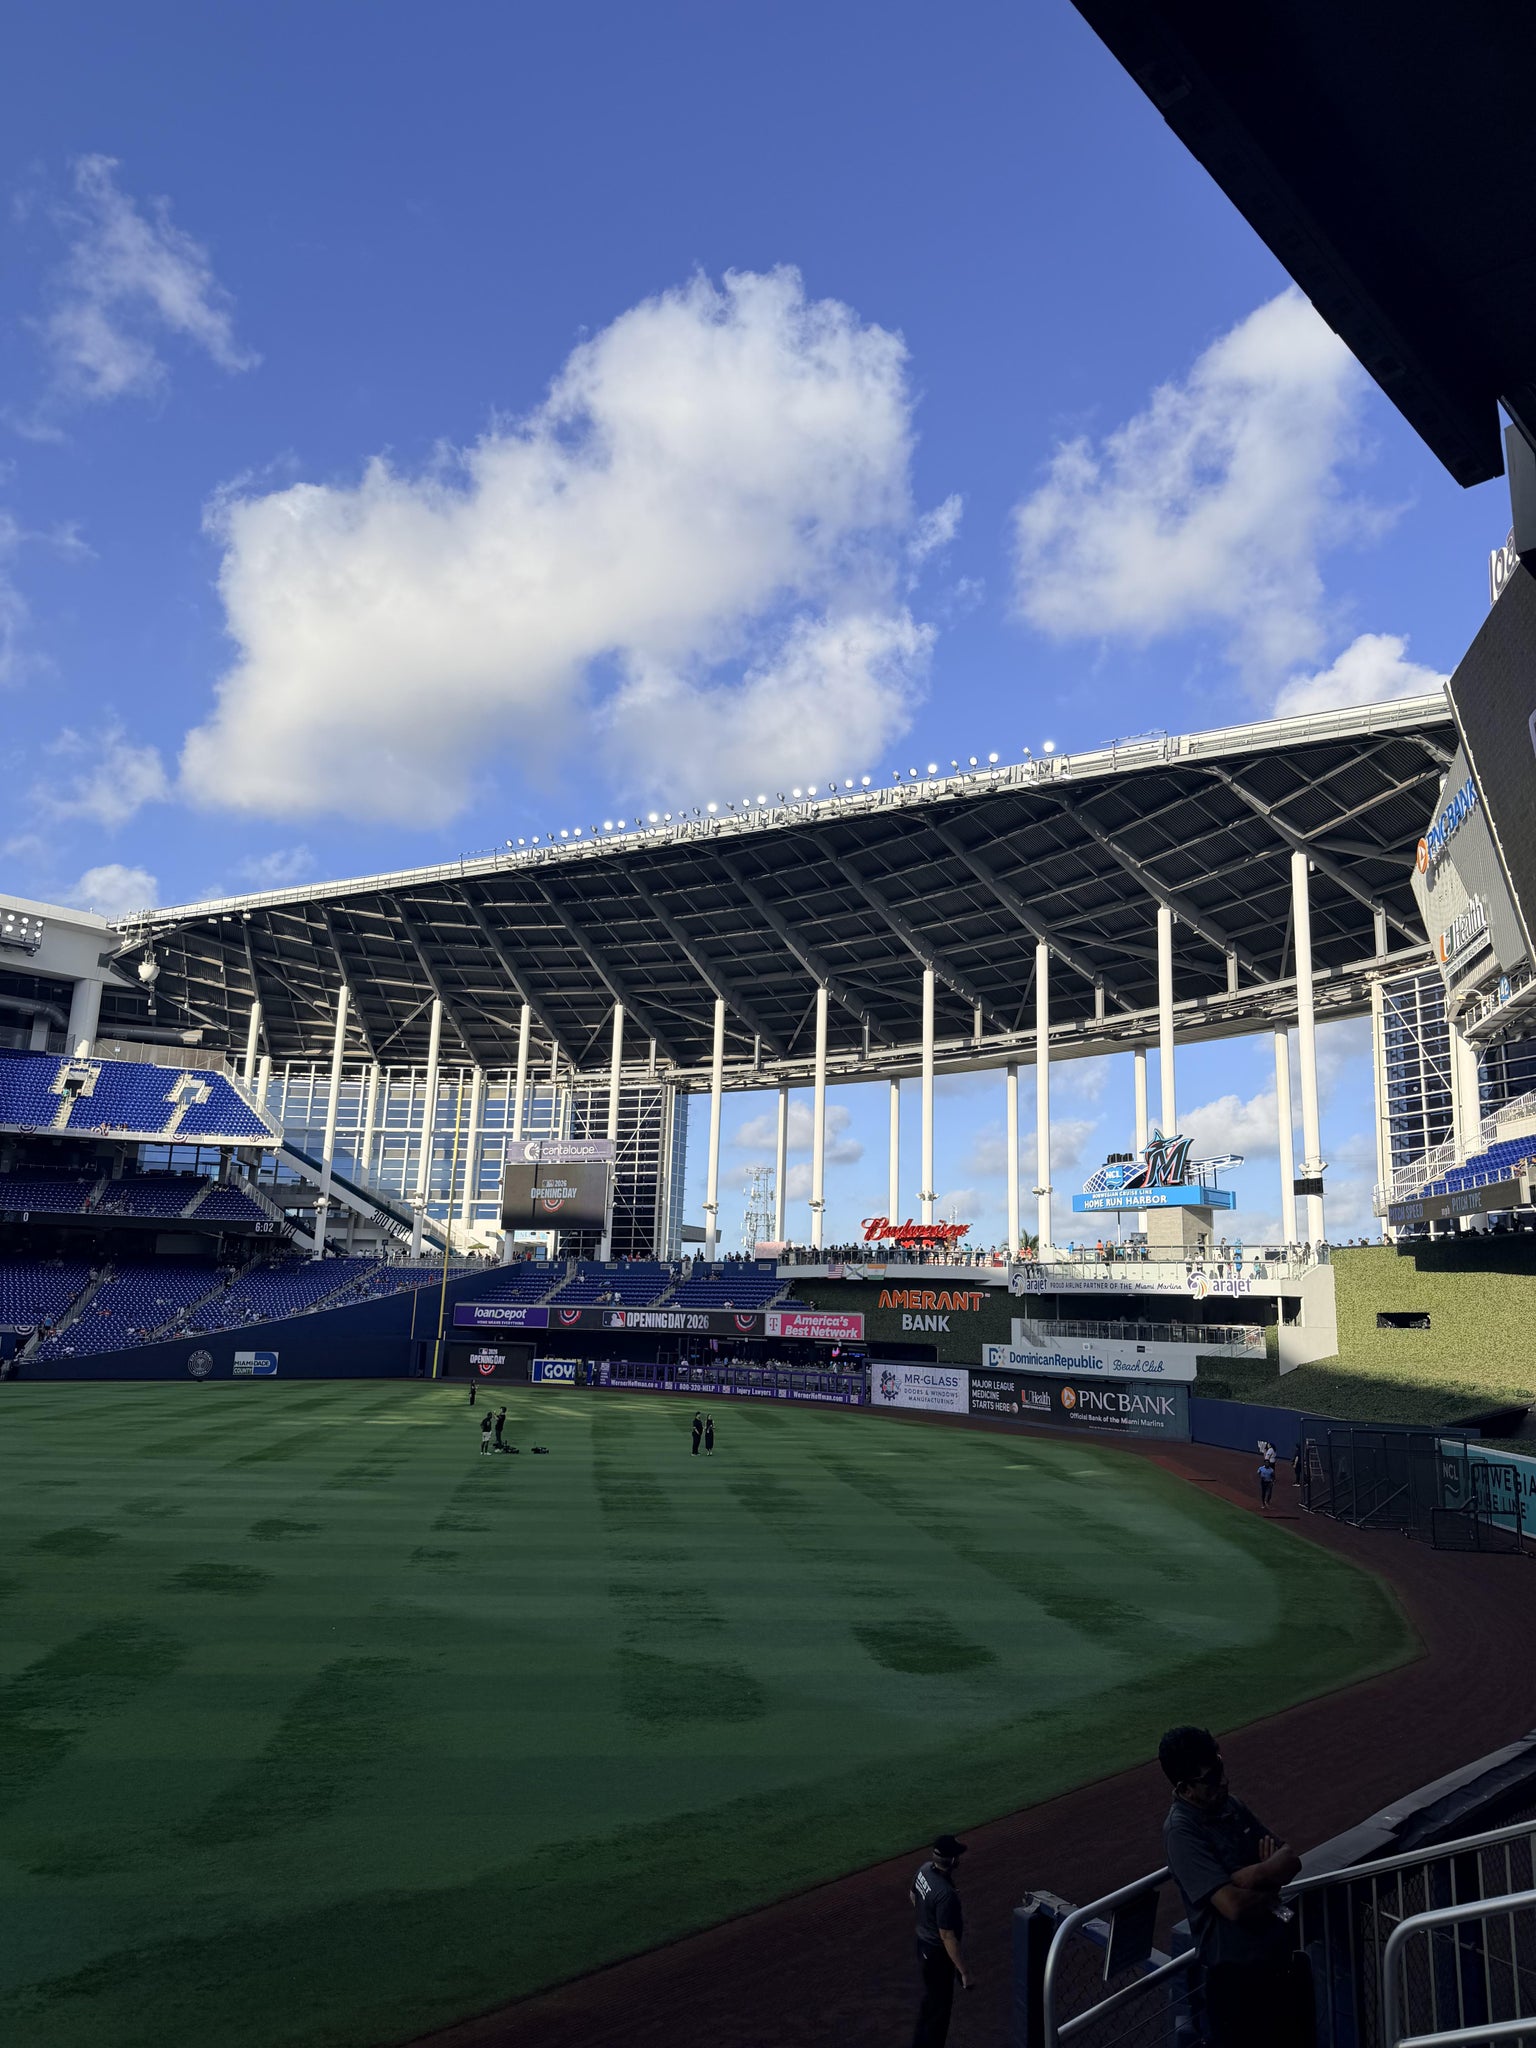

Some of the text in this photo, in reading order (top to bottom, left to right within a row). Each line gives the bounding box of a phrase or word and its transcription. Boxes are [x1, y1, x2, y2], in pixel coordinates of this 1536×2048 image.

[543, 1144, 595, 1156] cantaloupe
[1106, 1168, 1122, 1179] NCL
[531, 1187, 578, 1199] OPENING DAY
[1092, 1191, 1119, 1199] NORWEGIAN
[1084, 1195, 1167, 1209] HOME RUN HARBOR
[1451, 1192, 1483, 1212] PITCH TYPE
[1389, 1203, 1424, 1222] PITCH SPEED
[255, 1222, 274, 1233] 6:02
[370, 1209, 413, 1242] 300 LEVEL
[861, 1217, 971, 1241] Budweiser
[1026, 1278, 1048, 1295] arajet
[1083, 1282, 1109, 1290] PARTNER
[1212, 1278, 1252, 1297] arajet
[878, 1289, 984, 1311] AMERANT
[474, 1307, 527, 1320] loanDepot
[626, 1312, 709, 1329] OPENING DAY 2026
[793, 1315, 849, 1327] America's
[902, 1314, 951, 1332] BANK
[785, 1325, 858, 1338] Best Network
[470, 1354, 506, 1365] OPENING DAY
[1112, 1359, 1141, 1373] Beach
[1141, 1361, 1165, 1374] Club
[904, 1373, 958, 1387] MR-GLASS
[972, 1379, 1015, 1391] MAJOR LEAGUE
[736, 1386, 772, 1397] Injury Lawyers
[793, 1391, 844, 1402] WernerHoffman.com
[972, 1390, 1000, 1400] MEDICINE
[1021, 1389, 1051, 1406] UHealth
[908, 1395, 954, 1405] MANUFACTURING
[972, 1400, 994, 1410] STARTS
[995, 1401, 1010, 1412] HERE
[1069, 1412, 1088, 1421] Official
[1088, 1414, 1102, 1422] Bank
[1120, 1417, 1140, 1426] Miami
[1140, 1419, 1164, 1427] Marlins
[1442, 1461, 1459, 1481] NCL
[1502, 1497, 1528, 1520] LINE
